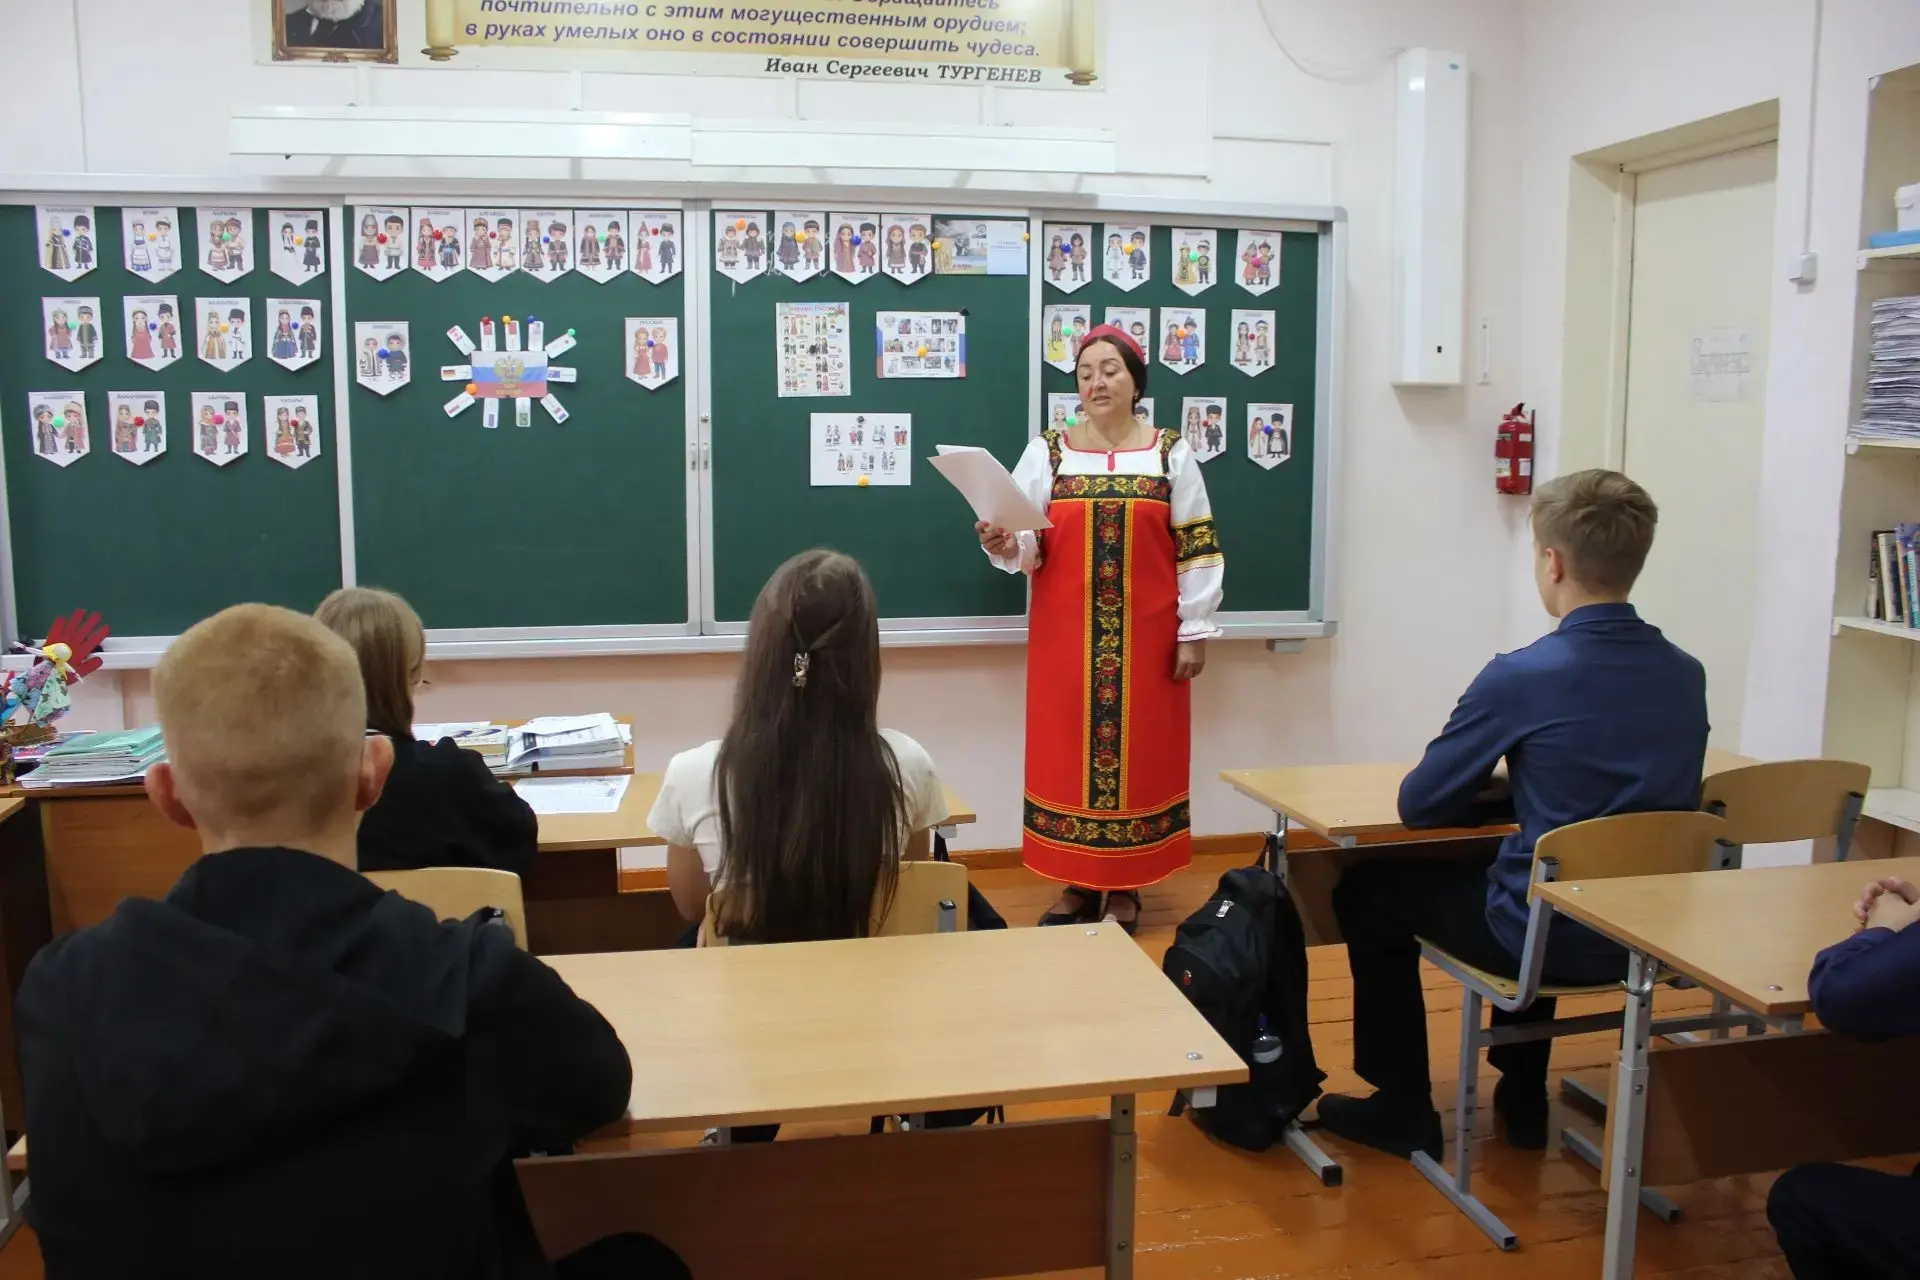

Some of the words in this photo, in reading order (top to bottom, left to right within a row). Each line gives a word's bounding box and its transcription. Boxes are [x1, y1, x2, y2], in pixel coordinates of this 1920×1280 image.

[480, 0, 638, 16] почтительно
[646, 5, 657, 18] с
[664, 6, 723, 20] этим
[731, 8, 926, 29] могущественным
[465, 23, 477, 36] в
[485, 22, 546, 40] руках
[553, 24, 638, 42] умелых
[646, 28, 685, 42] оно
[692, 29, 703, 42] в
[711, 29, 830, 46] состоянии
[838, 35, 959, 53] совершить
[966, 39, 1040, 57] чудеса.
[765, 58, 818, 73] Иван
[826, 59, 929, 79] Сергеевич
[937, 65, 1041, 83] ТУРГЕНЕВ
